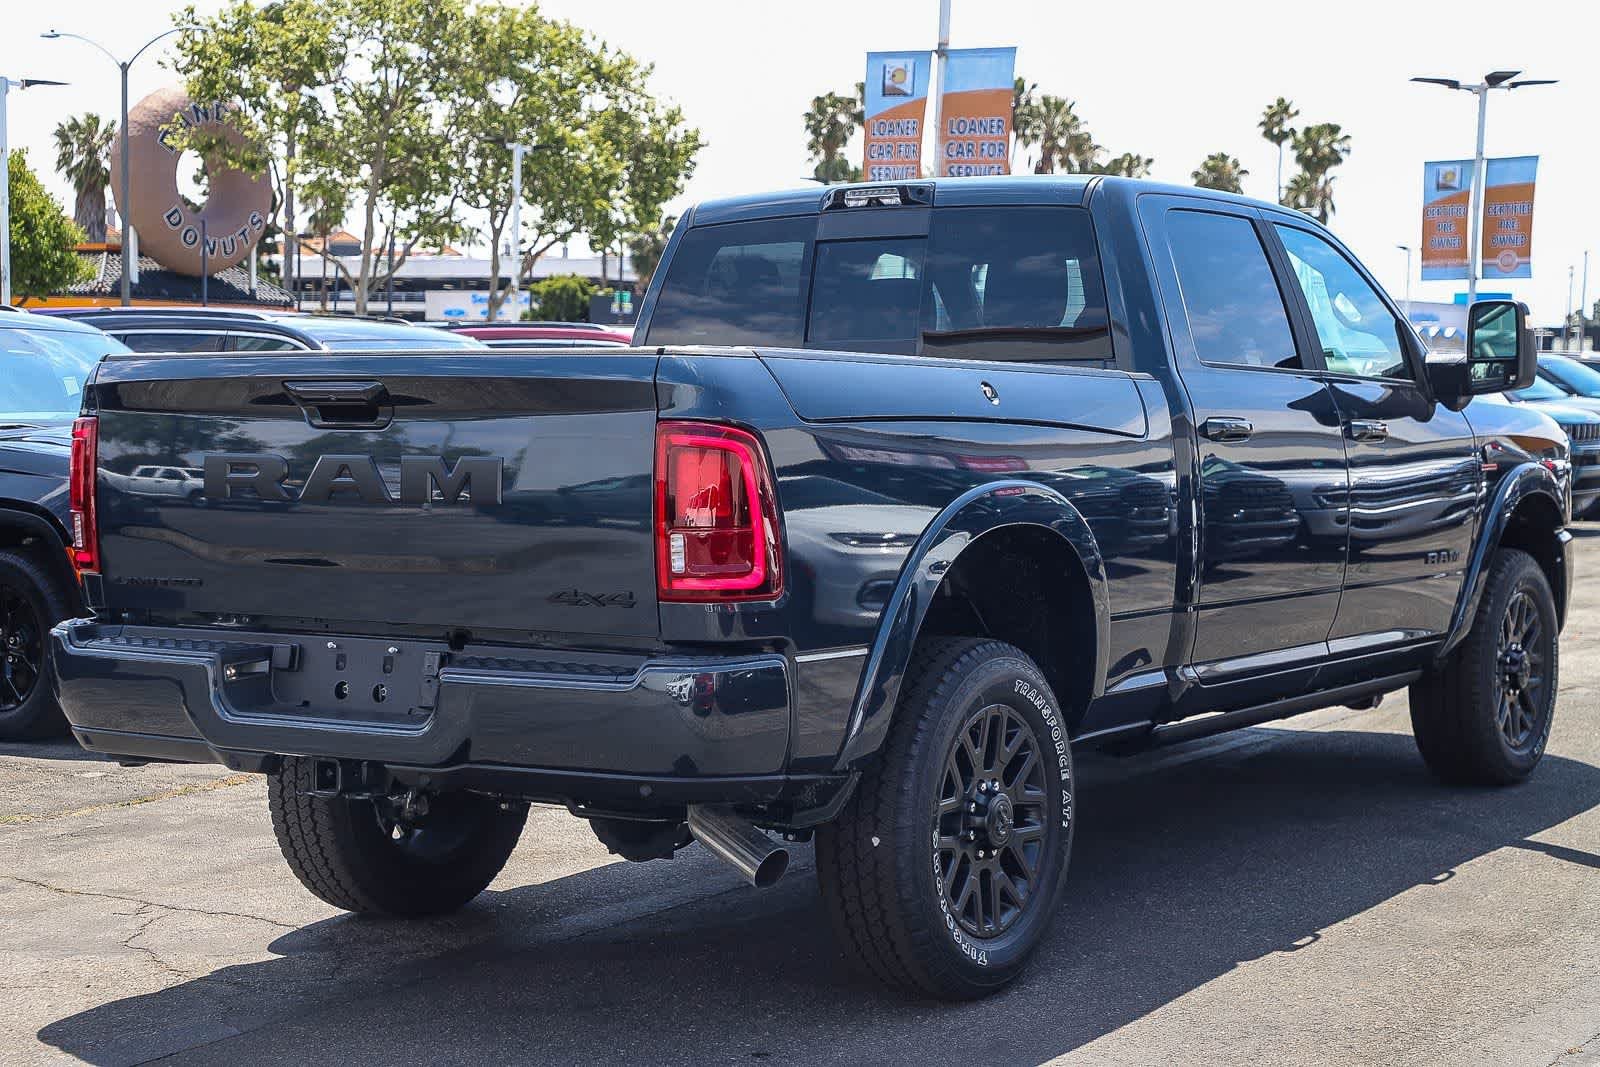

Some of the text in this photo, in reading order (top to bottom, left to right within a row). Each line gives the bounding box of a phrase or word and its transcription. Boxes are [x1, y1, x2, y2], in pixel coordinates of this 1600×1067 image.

[870, 119, 919, 138] LOANER
[948, 117, 1006, 136] LOANER
[868, 142, 918, 161] CAR FOR
[945, 139, 1007, 159] CAR FOR
[163, 206, 265, 258] DONUTS
[204, 454, 504, 505] RAM
[1013, 679, 1070, 781] TRANSFORCE
